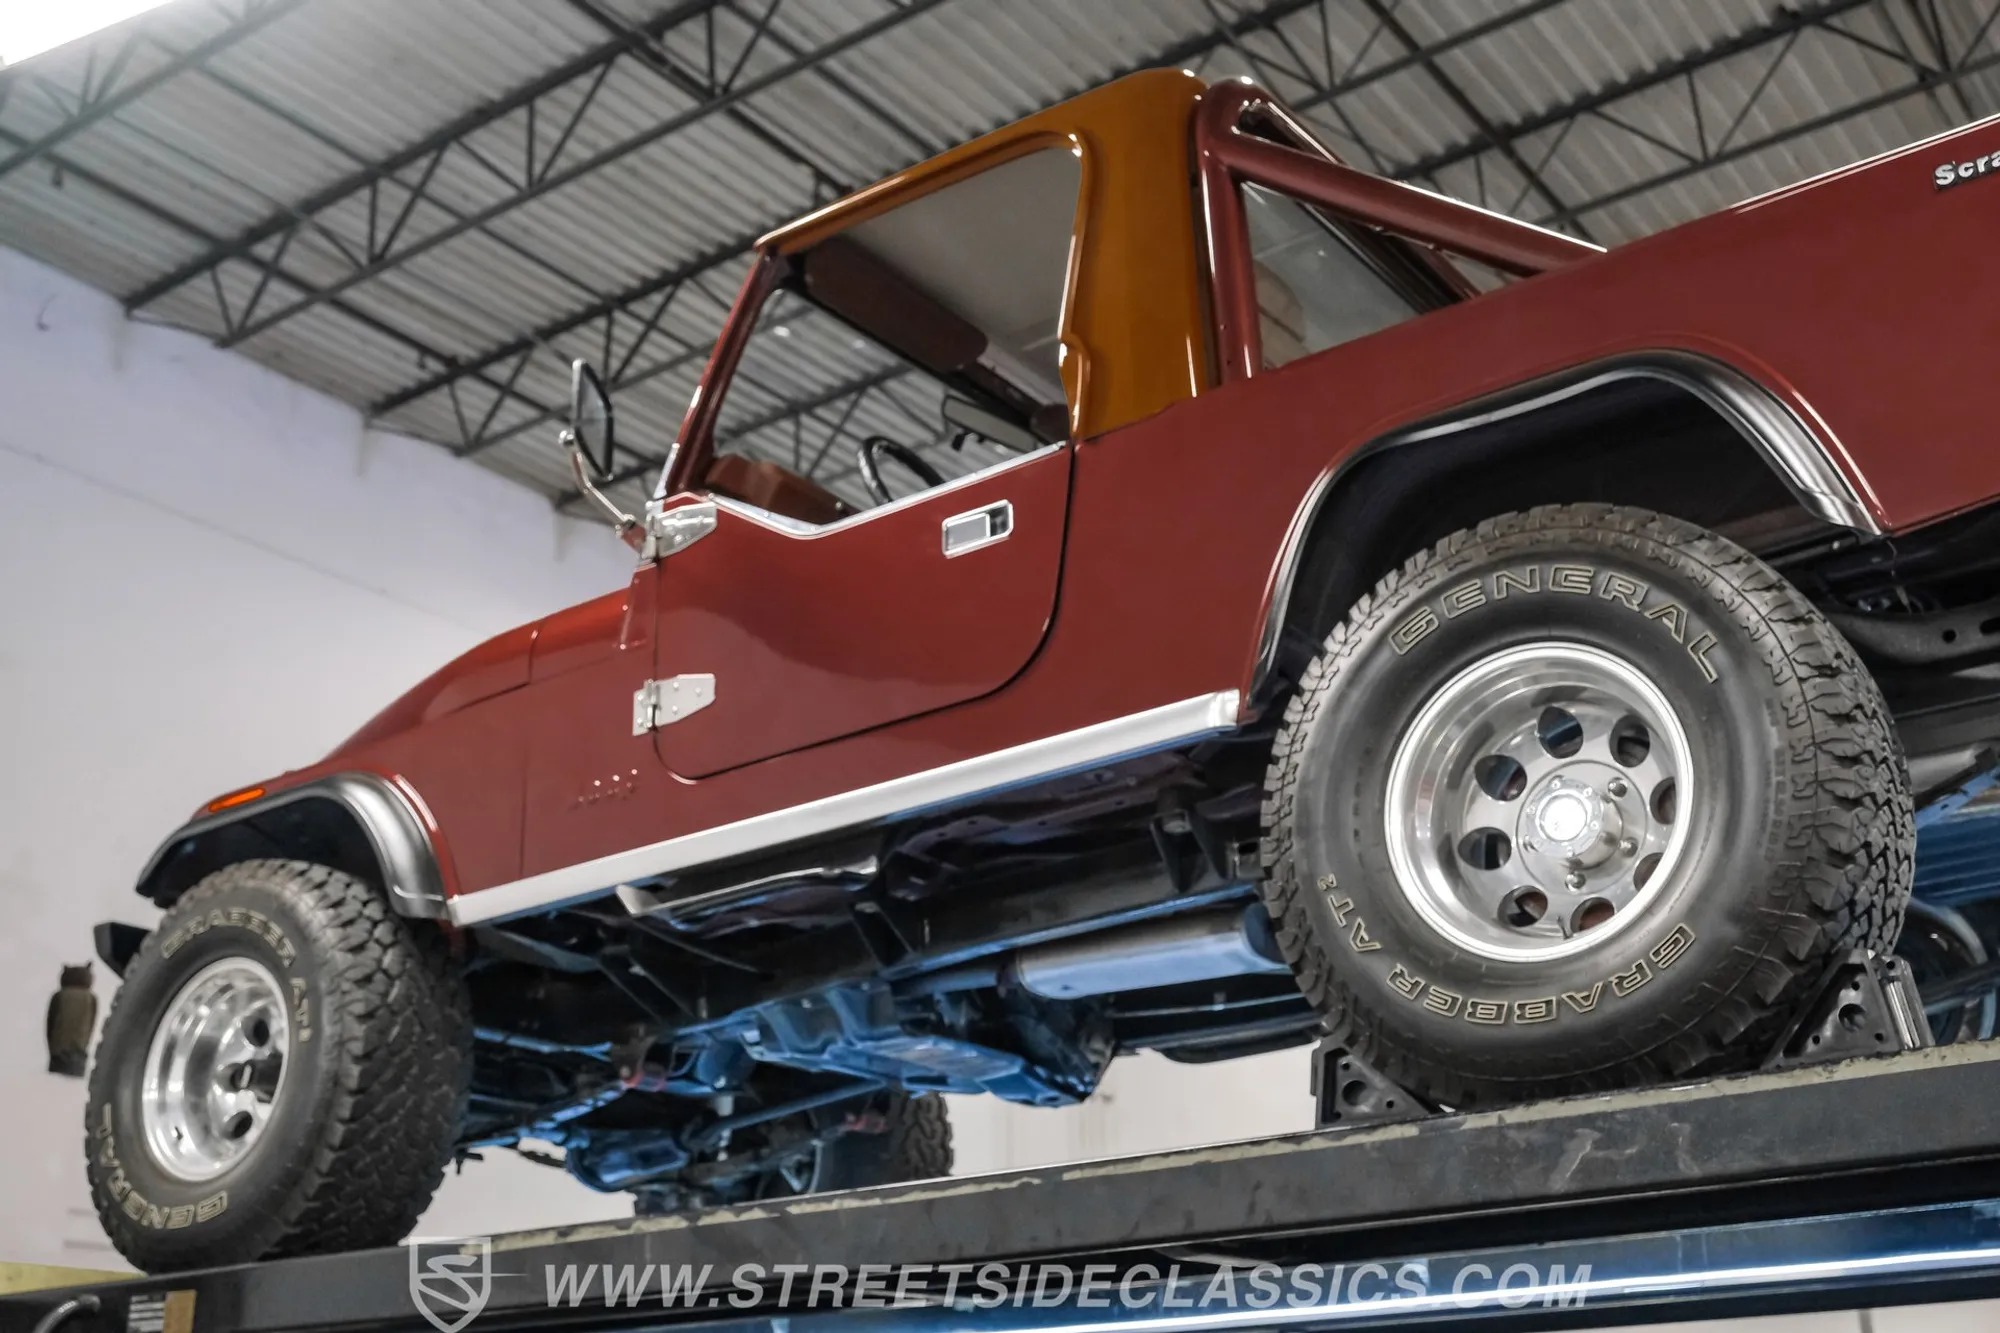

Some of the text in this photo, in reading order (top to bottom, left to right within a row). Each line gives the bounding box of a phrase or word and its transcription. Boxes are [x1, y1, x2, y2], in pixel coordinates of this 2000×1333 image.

[1388, 564, 1719, 684] GENERAL
[161, 907, 296, 968] GRABBER
[1386, 923, 1697, 1025] GRABBER
[99, 1102, 228, 1230] GENERAL
